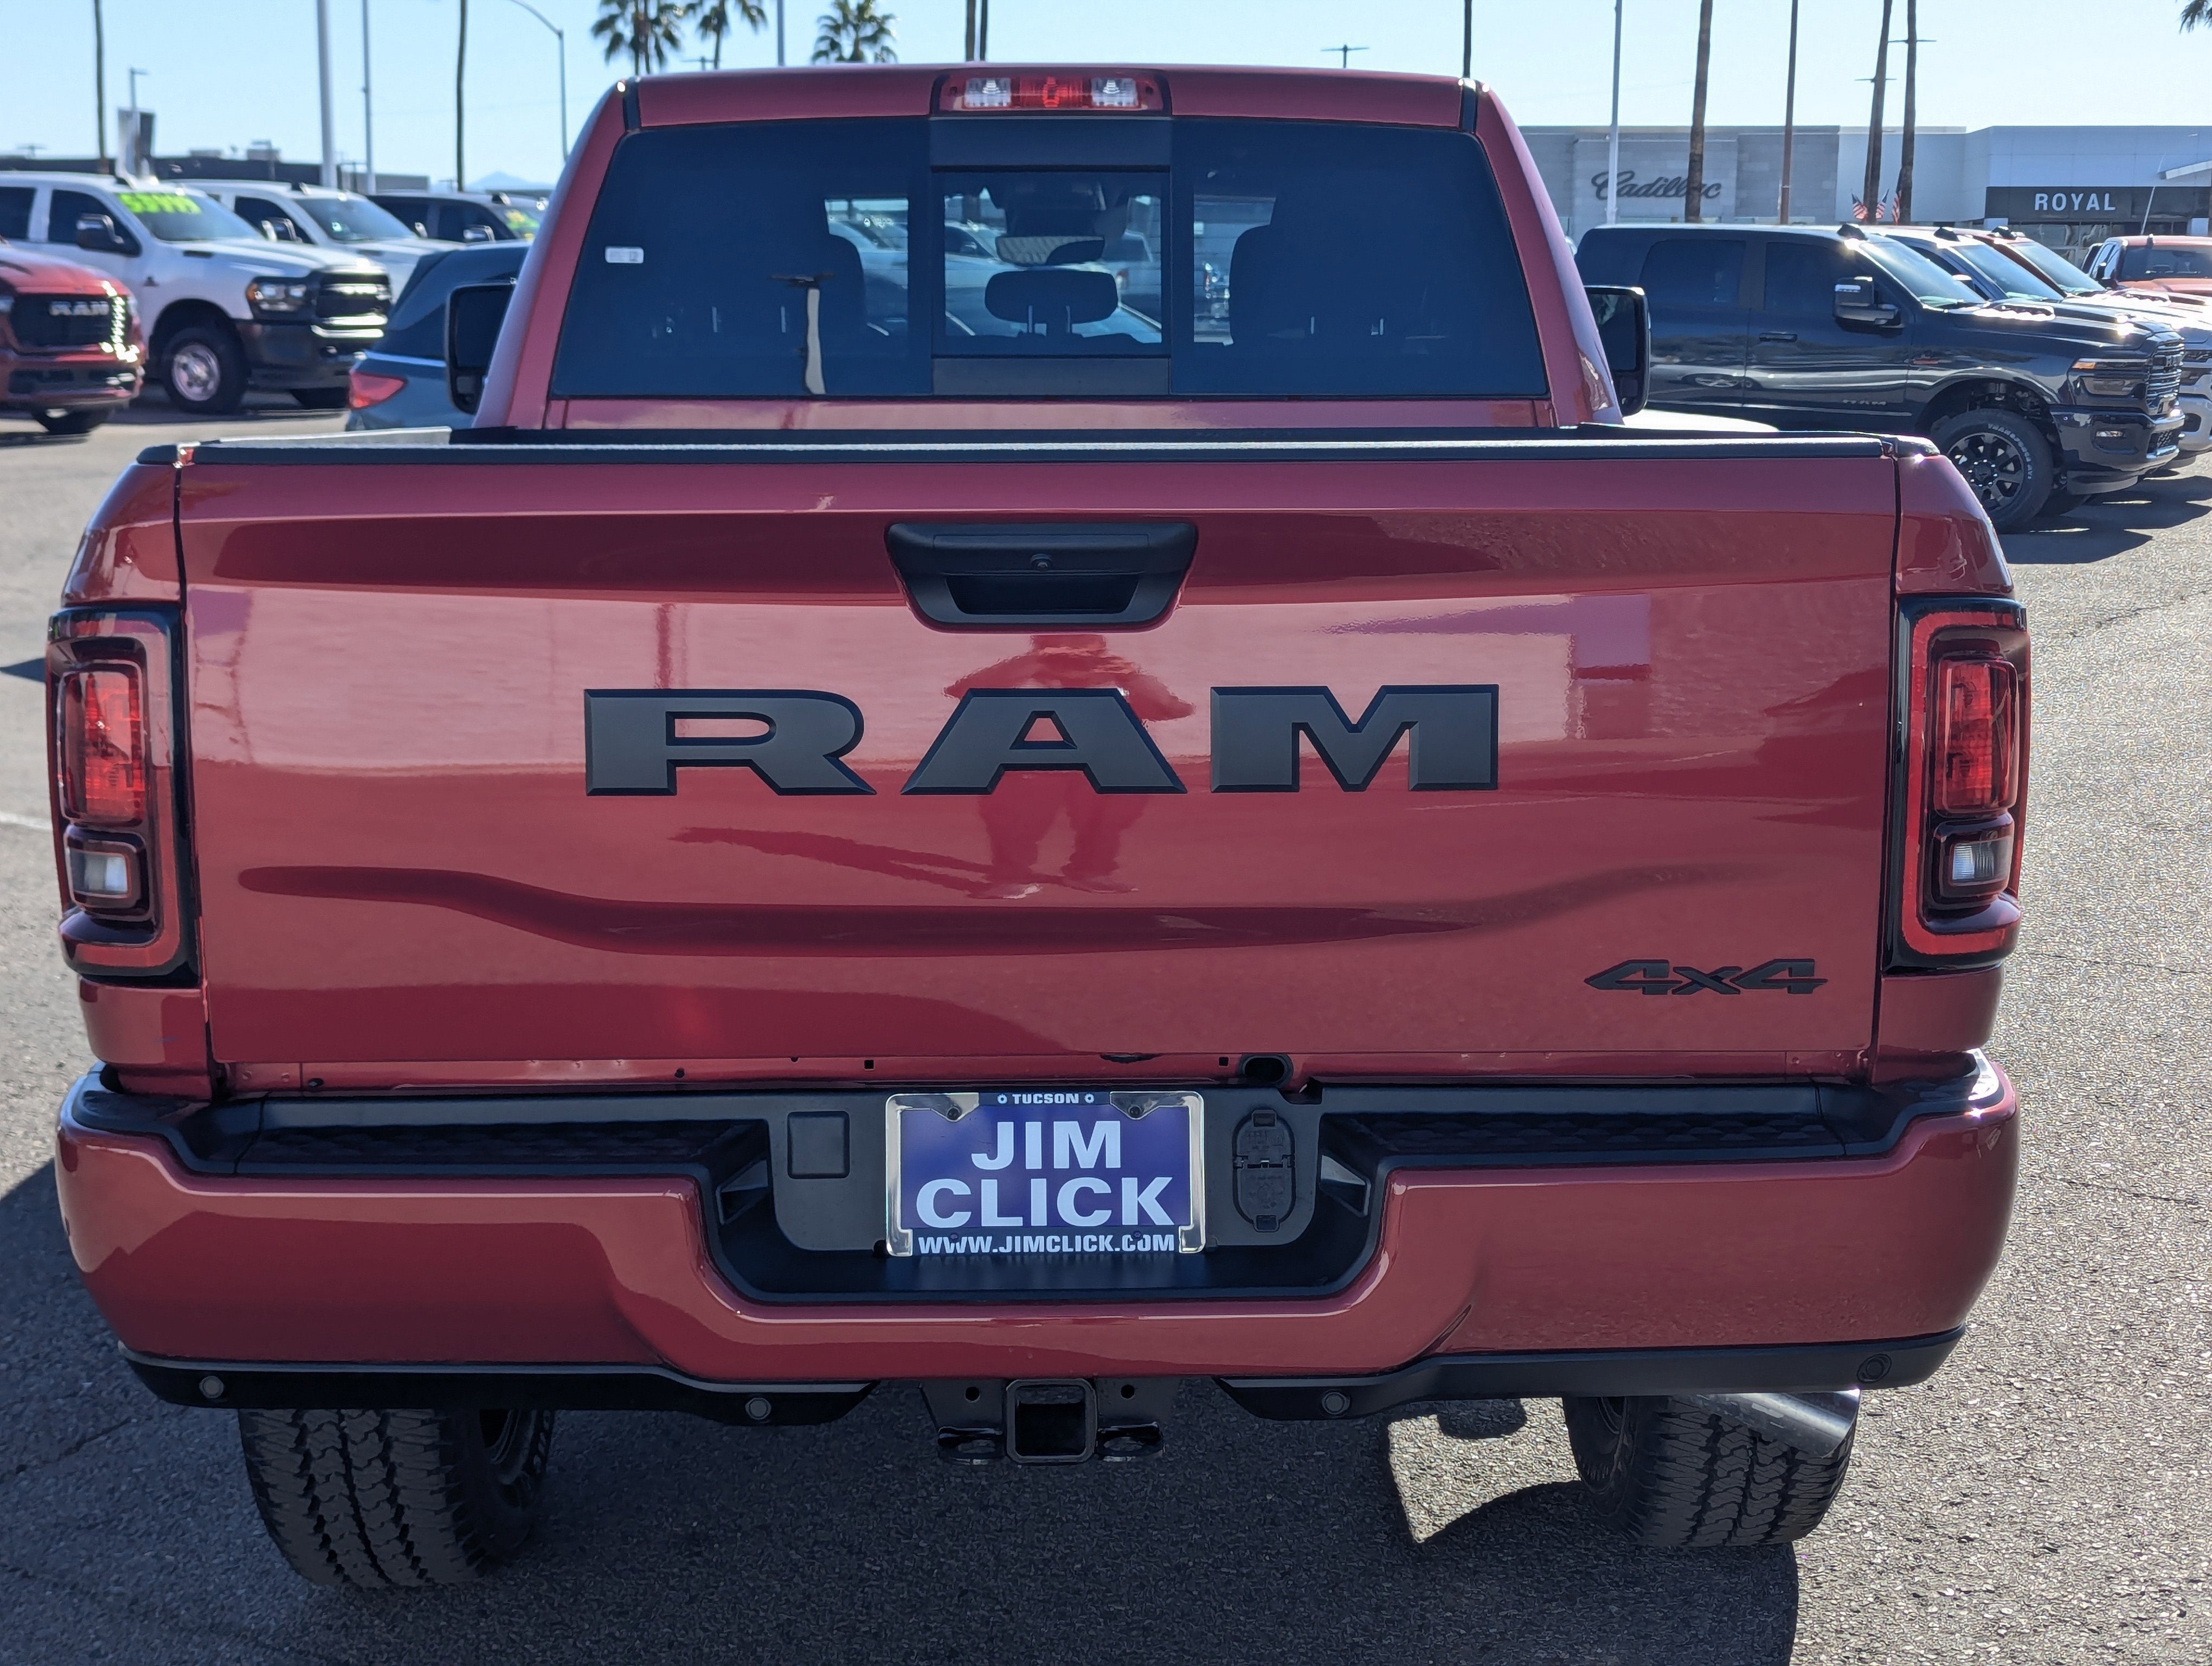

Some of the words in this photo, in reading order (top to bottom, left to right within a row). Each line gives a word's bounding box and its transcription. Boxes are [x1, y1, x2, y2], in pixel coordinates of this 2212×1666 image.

[1591, 170, 1722, 201] Cadillc
[2034, 193, 2117, 212] ROYAL
[49, 300, 110, 316] RAM
[584, 684, 1499, 795] RAM
[1584, 958, 1828, 995] 4x4
[1012, 1093, 1079, 1105] TUCSON
[971, 1121, 1121, 1170] JIM
[916, 1177, 1174, 1228] CLICK
[918, 1234, 1175, 1254] WWW.JIMCLICK.COM
